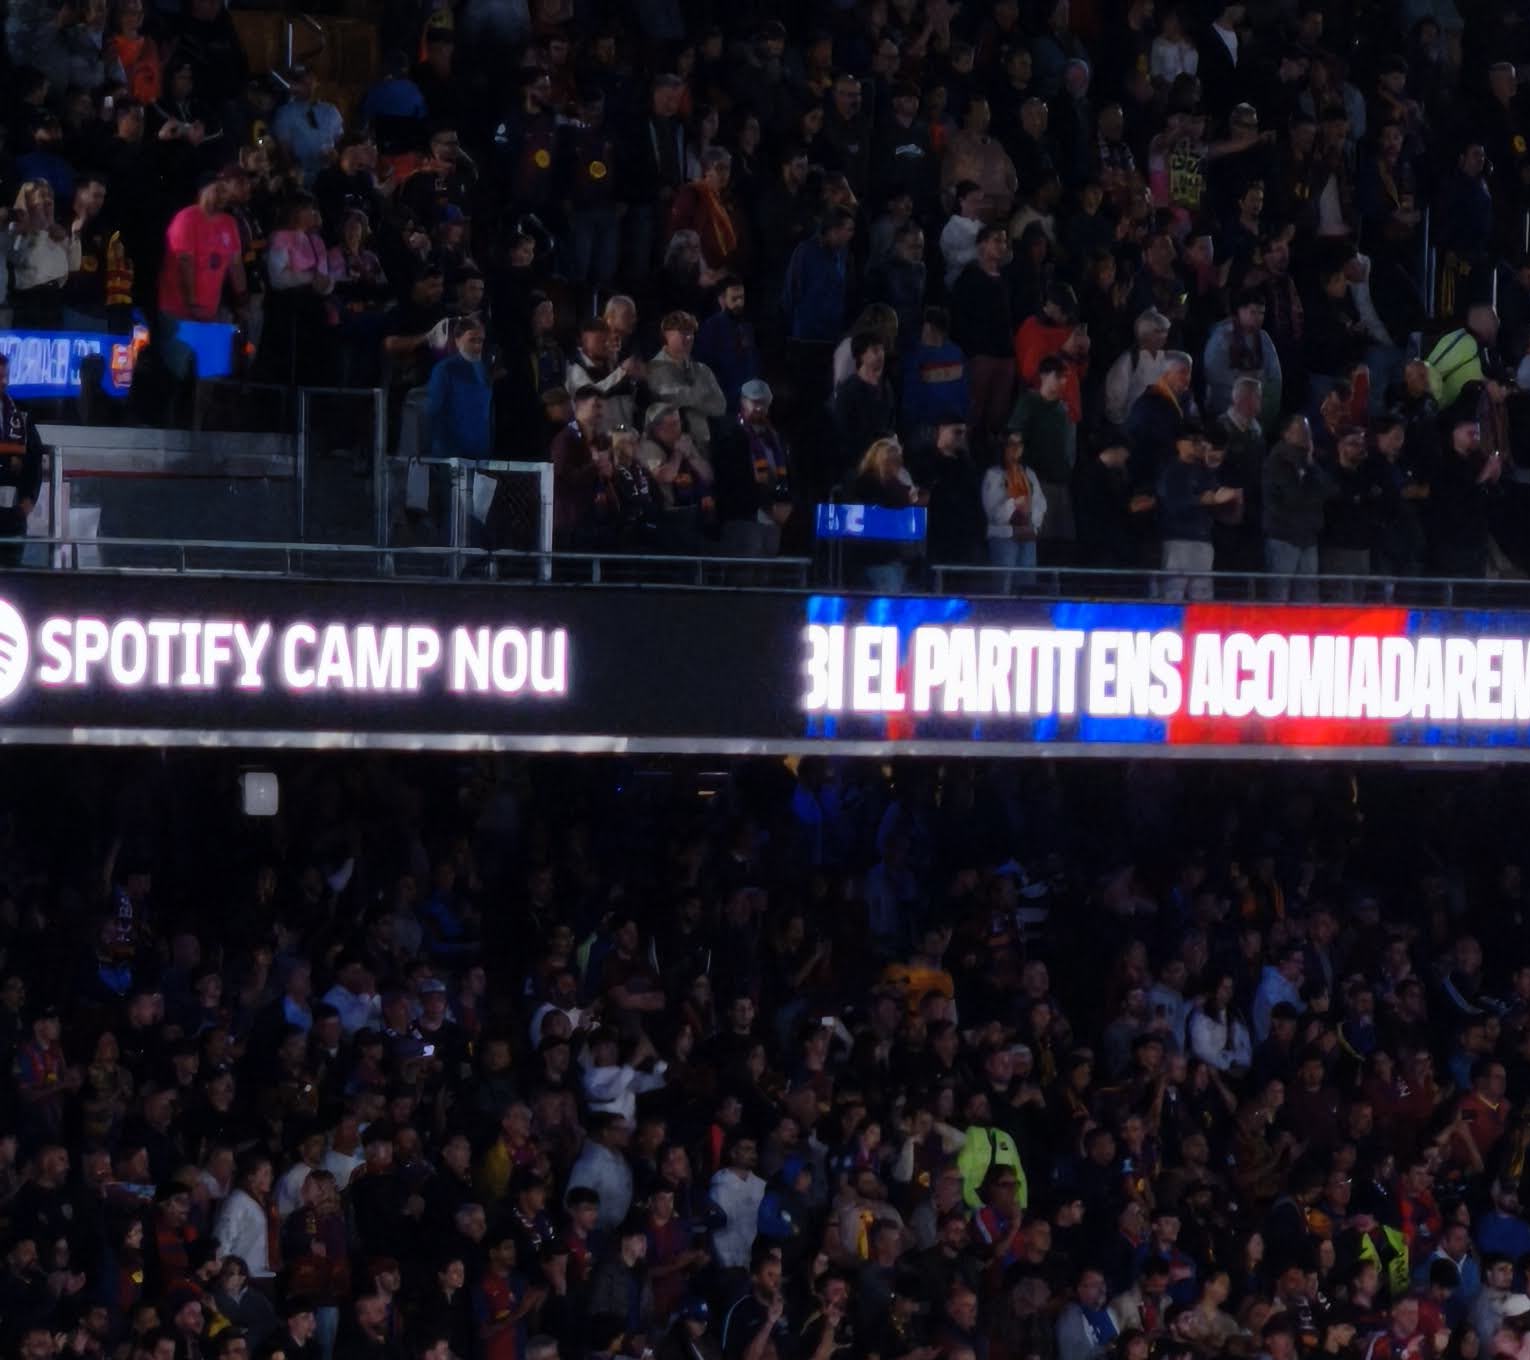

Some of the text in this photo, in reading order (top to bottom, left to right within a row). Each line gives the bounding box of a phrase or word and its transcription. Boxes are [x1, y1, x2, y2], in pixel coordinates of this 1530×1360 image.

[39, 619, 567, 694] SPOTIFY CAMP NOU
[852, 625, 906, 711] EL
[913, 626, 1085, 713] PARTIT
[1090, 630, 1182, 716] ENS
